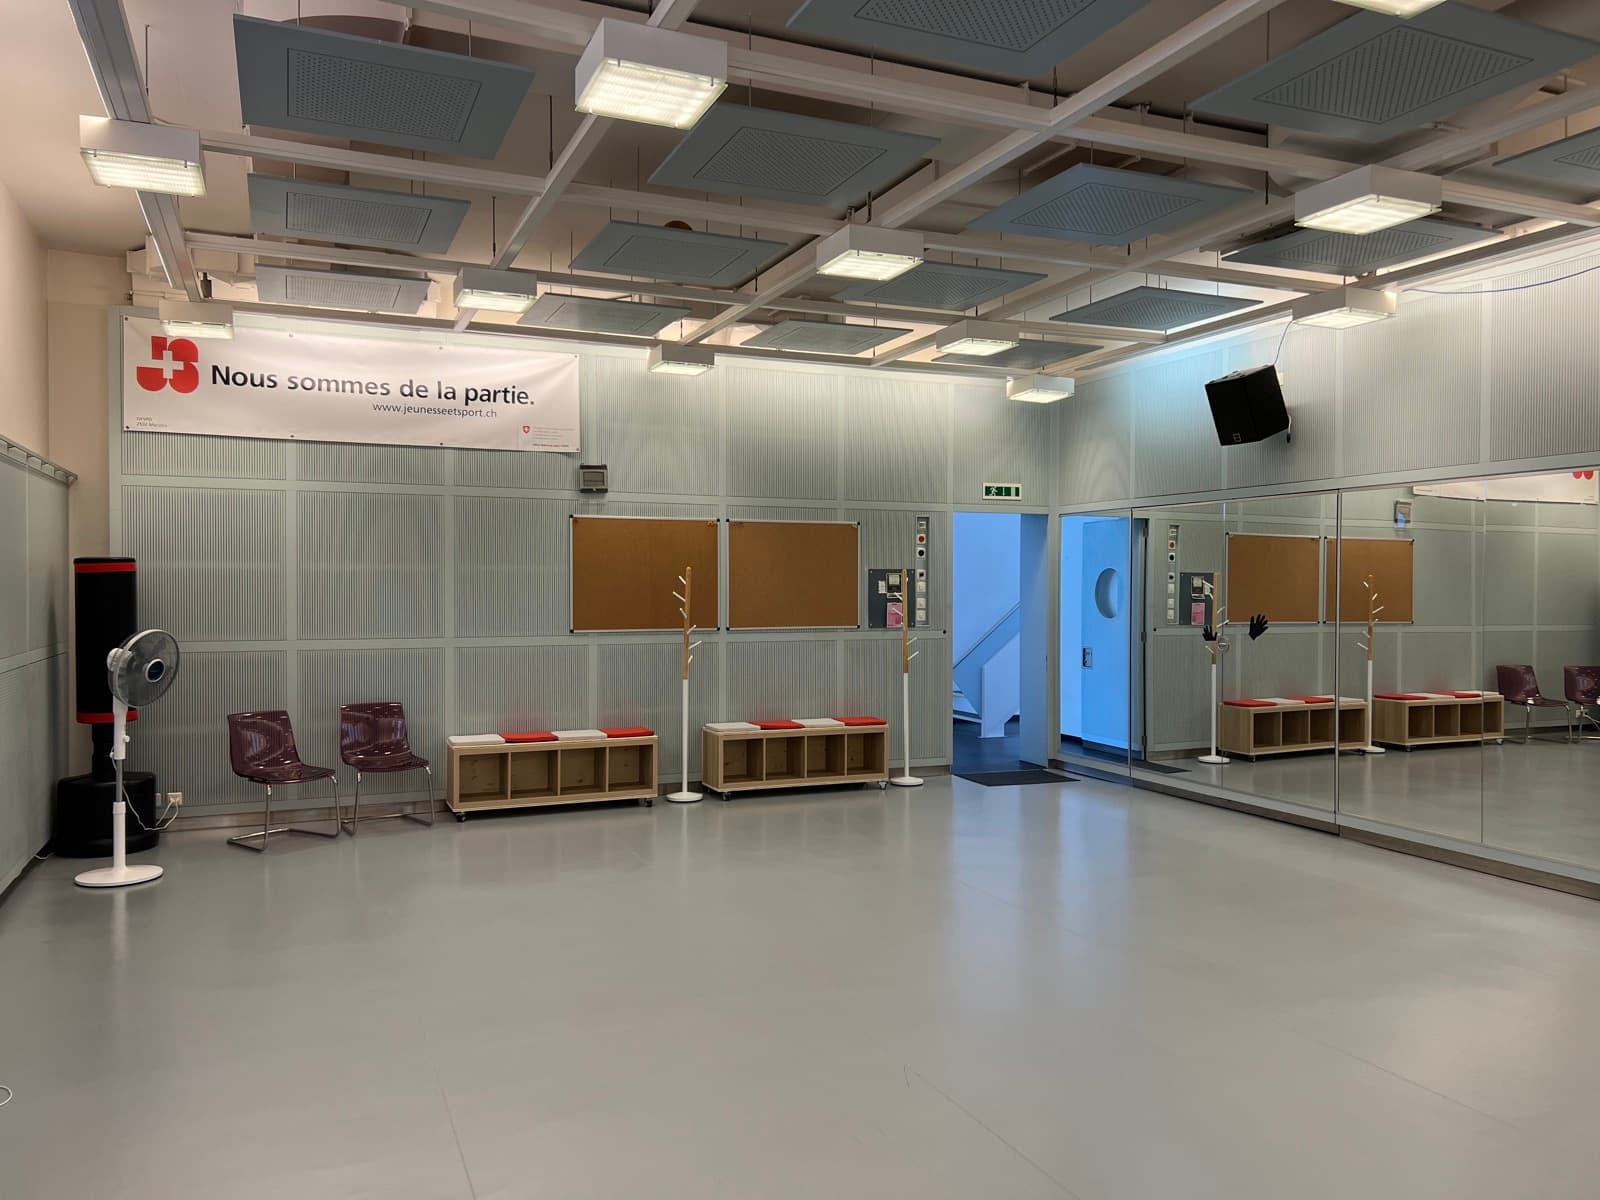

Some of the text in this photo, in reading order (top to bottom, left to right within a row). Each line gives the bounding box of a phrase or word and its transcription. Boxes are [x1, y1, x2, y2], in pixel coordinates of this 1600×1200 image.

[211, 365, 535, 406] Nous sommes de la partie.
[372, 402, 497, 418] www.jeunesseetsport.ch
